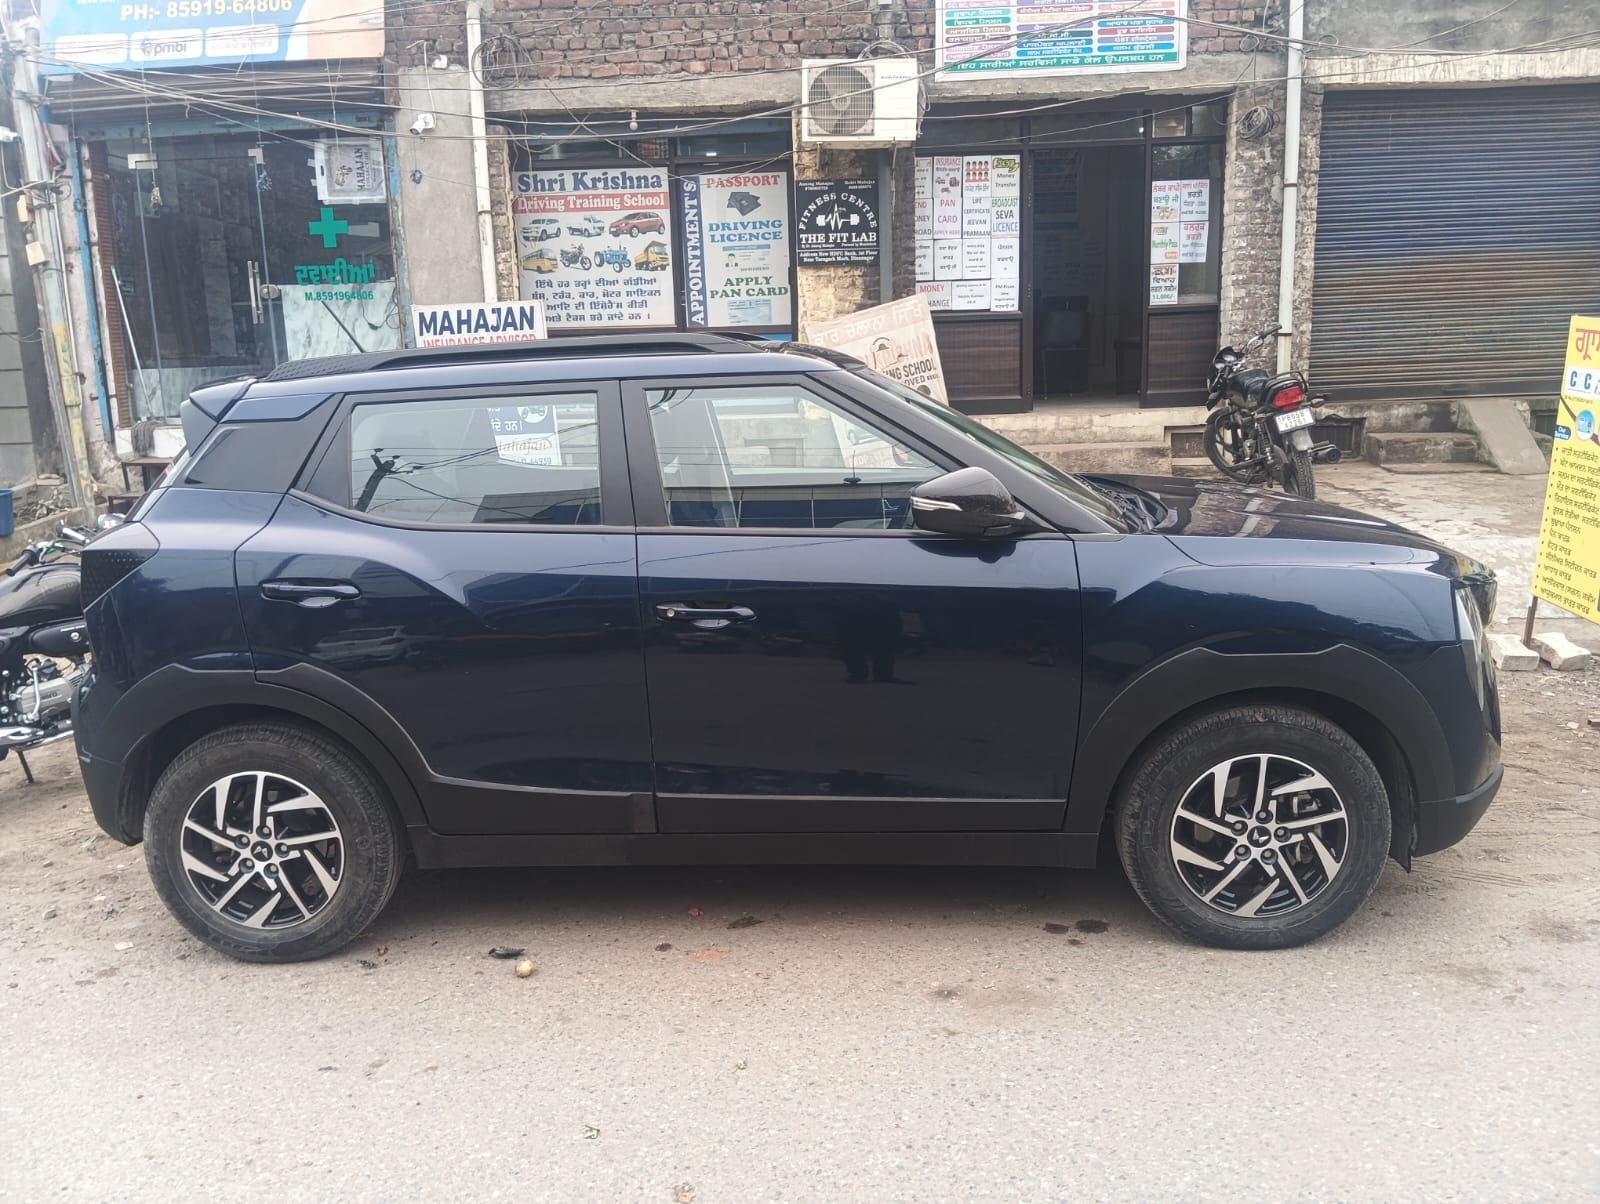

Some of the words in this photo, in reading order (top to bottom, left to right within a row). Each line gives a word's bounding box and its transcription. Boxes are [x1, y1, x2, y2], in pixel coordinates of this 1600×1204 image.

[165, 0, 293, 18] 85919-64806
[153, 42, 188, 58] pmbi
[518, 173, 566, 194] Shri
[572, 170, 663, 192] Krishna
[706, 173, 781, 190] PASSPORT
[518, 197, 566, 213] Driving
[567, 195, 622, 211] Training
[623, 193, 665, 208] School
[914, 201, 927, 209] END
[940, 199, 956, 208] PAN
[799, 192, 837, 231] FITNESS
[840, 192, 878, 229] CENTRE
[995, 209, 1014, 220] SEVA
[708, 219, 783, 233] DRIVING
[937, 215, 958, 224] CARD
[992, 221, 1018, 233] LICENCE
[710, 231, 783, 244] LICENCE
[800, 233, 826, 244] THE
[828, 232, 848, 243] FIT
[851, 231, 877, 242] LAB
[683, 180, 706, 326] APPOINTMENT'S
[724, 275, 774, 287] APPLY
[710, 288, 743, 299] PAN
[746, 286, 789, 298] CARD
[919, 284, 945, 293] MONEY
[927, 299, 951, 308] HANGE
[418, 304, 536, 338] MAHAJAN
[902, 357, 938, 379] SCHOOL
[903, 374, 927, 387] OVED
[499, 439, 548, 456] ahajan
